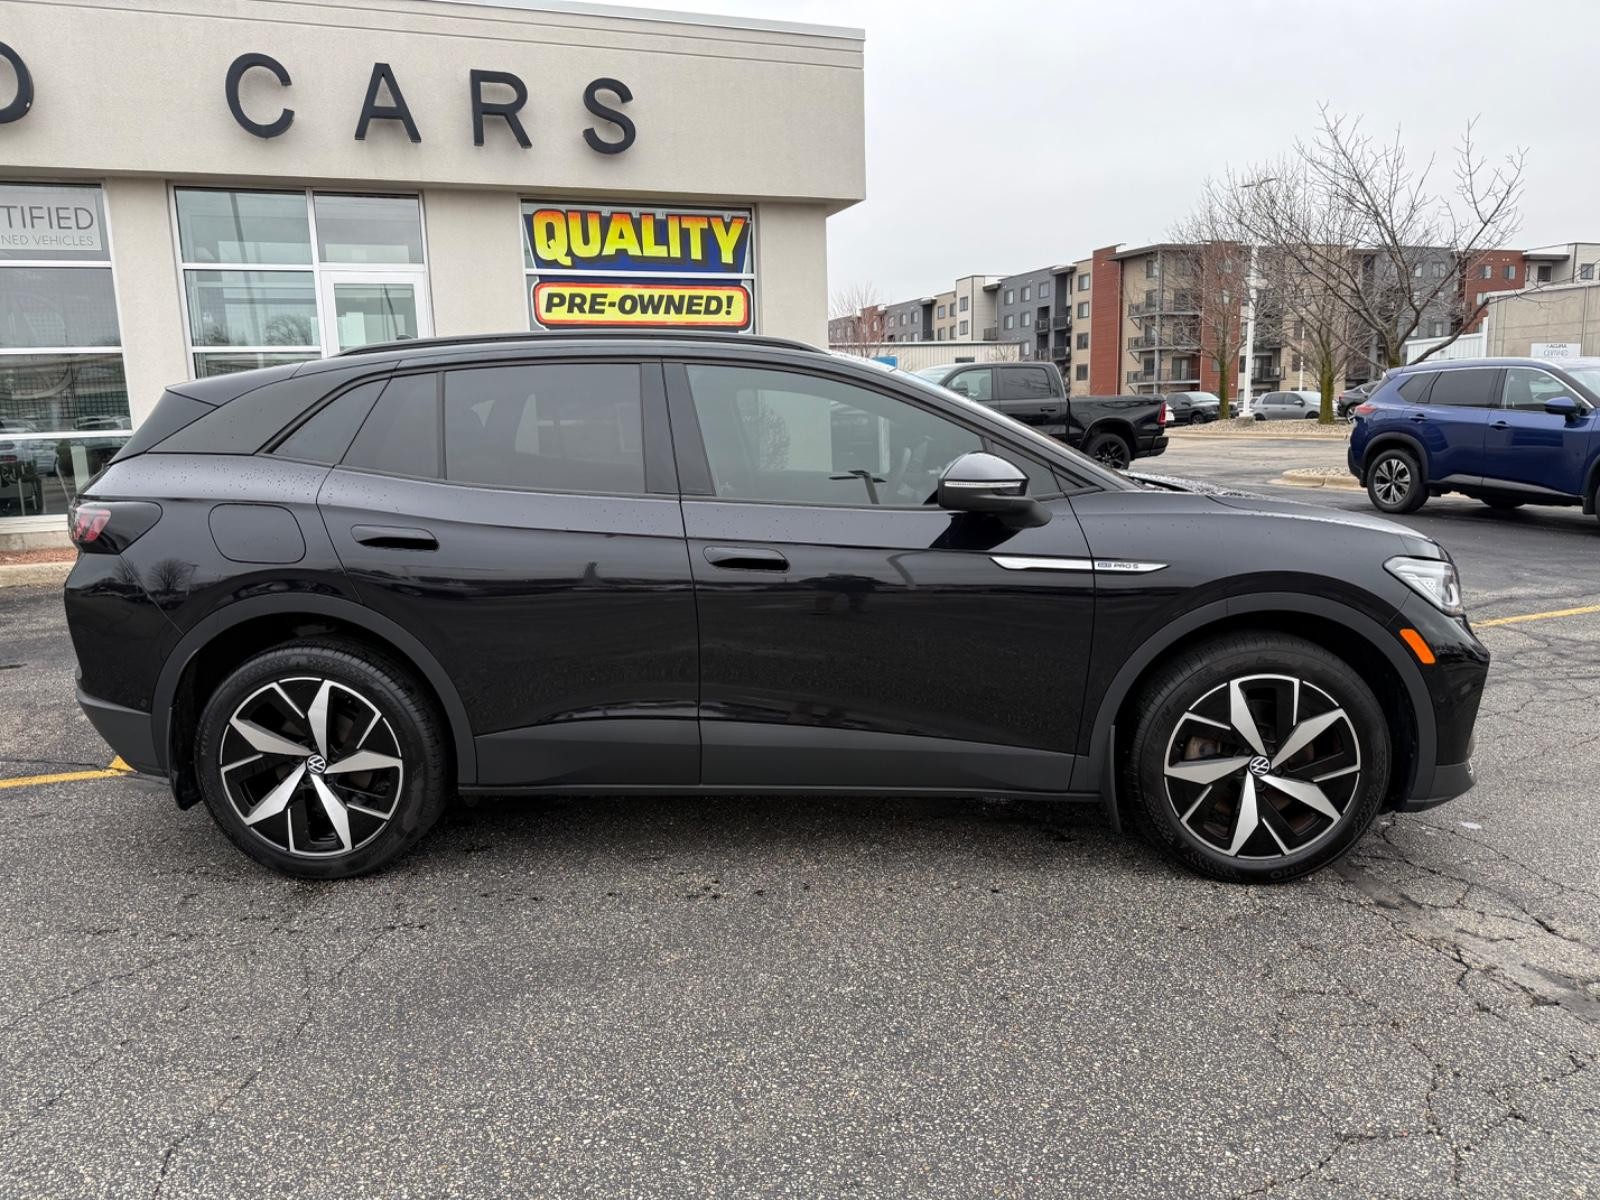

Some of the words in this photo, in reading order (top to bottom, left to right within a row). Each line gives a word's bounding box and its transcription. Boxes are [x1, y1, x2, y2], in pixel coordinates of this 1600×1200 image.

[225, 52, 637, 154] CARS
[32, 234, 94, 247] VEHICLES
[532, 209, 747, 267] QUALITY
[545, 291, 735, 316] PRE-OWNED!
